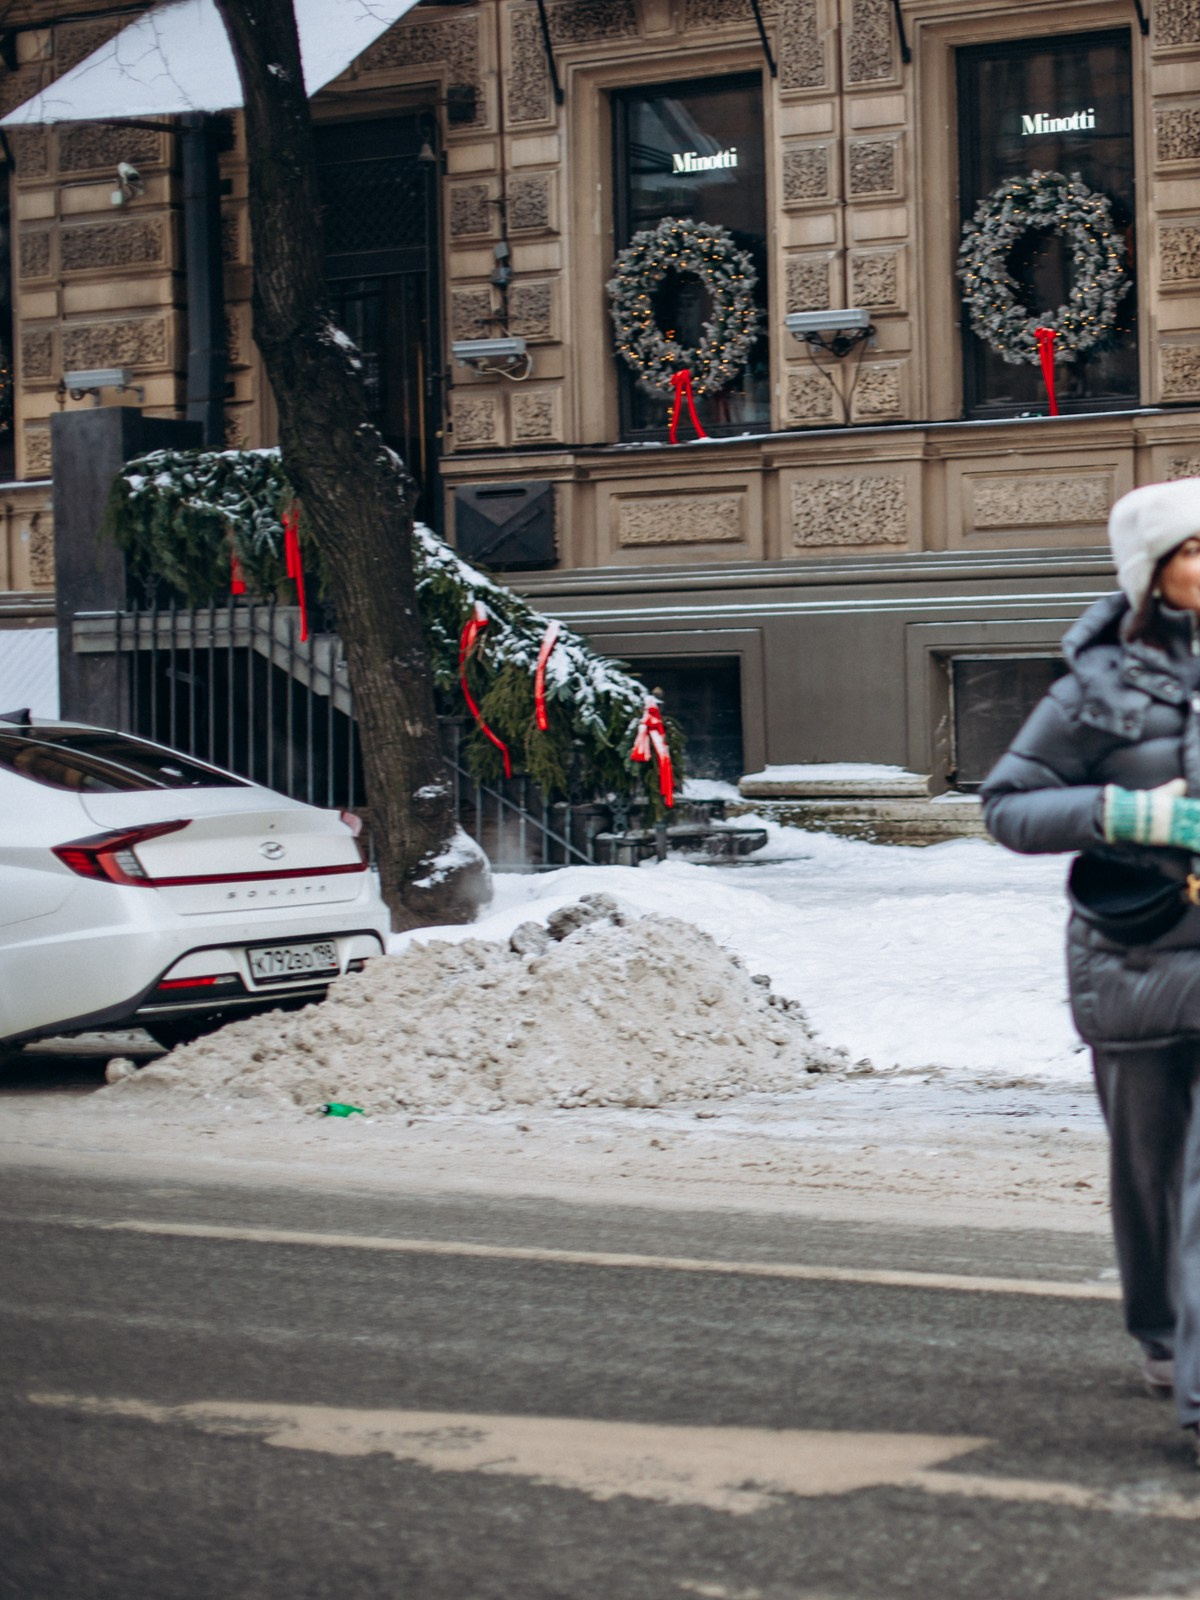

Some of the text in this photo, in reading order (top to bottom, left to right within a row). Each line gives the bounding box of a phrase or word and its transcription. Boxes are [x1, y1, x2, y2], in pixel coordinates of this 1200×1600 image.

[1021, 108, 1096, 136] Minotti
[672, 147, 738, 174] Minotti
[227, 885, 326, 899] SONATA
